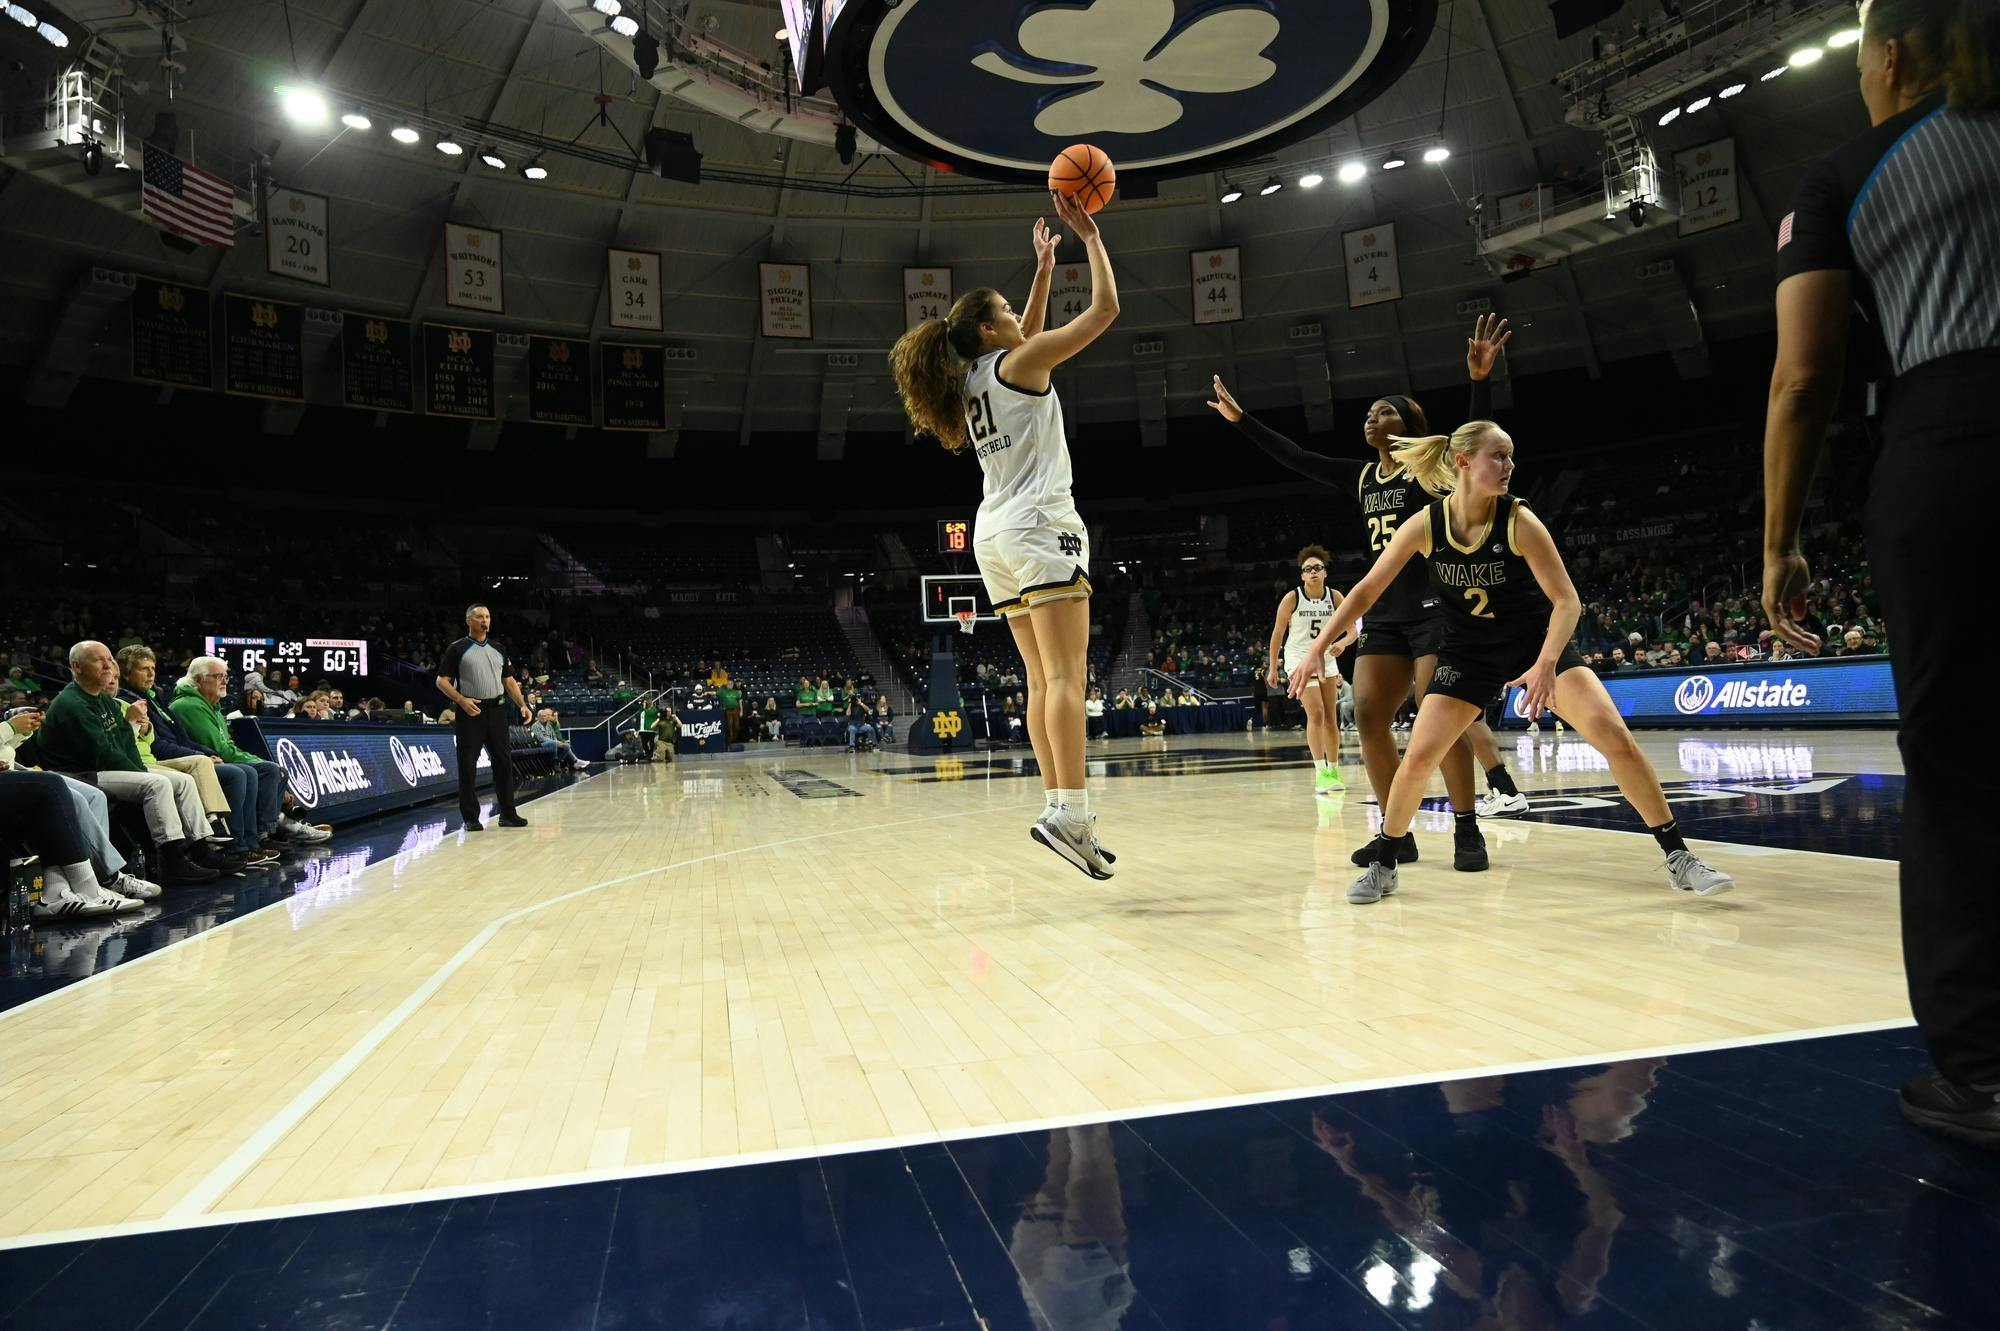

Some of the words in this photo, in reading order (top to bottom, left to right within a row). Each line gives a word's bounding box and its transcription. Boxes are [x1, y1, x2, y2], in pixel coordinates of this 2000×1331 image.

[1696, 186, 1718, 208] 12
[271, 217, 323, 237] HAWKINS
[287, 235, 310, 257] 20
[450, 253, 497, 267] WHITMORE
[1353, 251, 1389, 265] RIVERS
[464, 269, 485, 287] 53
[622, 275, 648, 286] CARR
[1196, 273, 1236, 285] TRIPUCKA
[1367, 266, 1379, 282] 4
[625, 291, 645, 308] 34
[767, 287, 804, 298] DIGGER
[908, 291, 948, 301] SHUMATE
[1052, 286, 1092, 298] DANTLEY
[1208, 287, 1227, 303] 44
[770, 296, 802, 306] PHELPS
[1064, 299, 1082, 315] 44
[920, 305, 938, 320] 34
[446, 354, 474, 364] NCAA
[440, 362, 471, 373] ELITE
[536, 380, 557, 391] 2016
[968, 391, 998, 442] 21
[977, 435, 1012, 460] ESTBELD
[1364, 488, 1406, 515] WAKE
[945, 523, 967, 533] 6:29
[1367, 514, 1397, 552] 25
[1615, 523, 1673, 542] CASSANDRE
[949, 532, 965, 550] 18
[1566, 533, 1597, 545] OLIVIA
[1435, 560, 1506, 587] WAKE
[671, 592, 701, 603] MADDY
[715, 592, 737, 603] KATE
[1464, 587, 1496, 619] 2
[1310, 619, 1322, 640] 5
[221, 637, 246, 646] NOTRE
[247, 638, 267, 646] DAME
[278, 642, 303, 656] 6:29
[242, 649, 267, 672] 85
[323, 650, 346, 672] 60
[288, 666, 294, 675] 4
[694, 720, 722, 739] Fight
